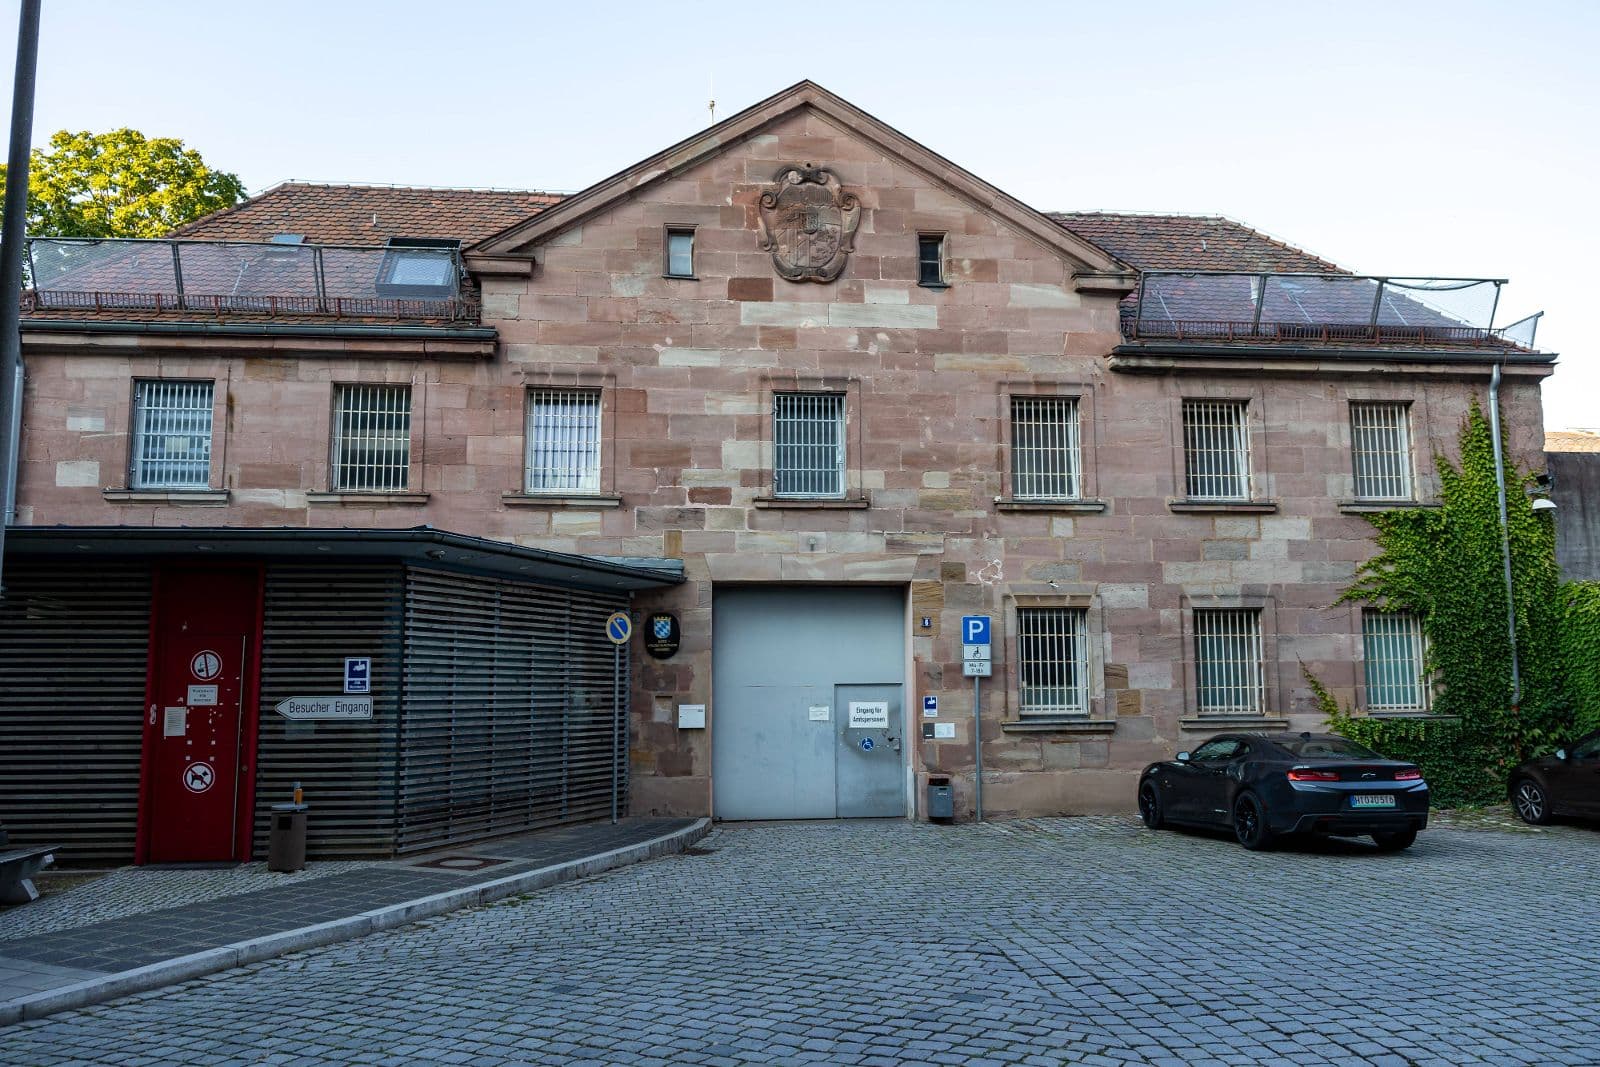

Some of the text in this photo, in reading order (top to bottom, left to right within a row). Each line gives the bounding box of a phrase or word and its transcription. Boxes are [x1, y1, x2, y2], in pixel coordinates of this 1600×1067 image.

[969, 620, 984, 641] P
[289, 701, 369, 714] Besucher Eingang
[856, 707, 874, 715] Eingang
